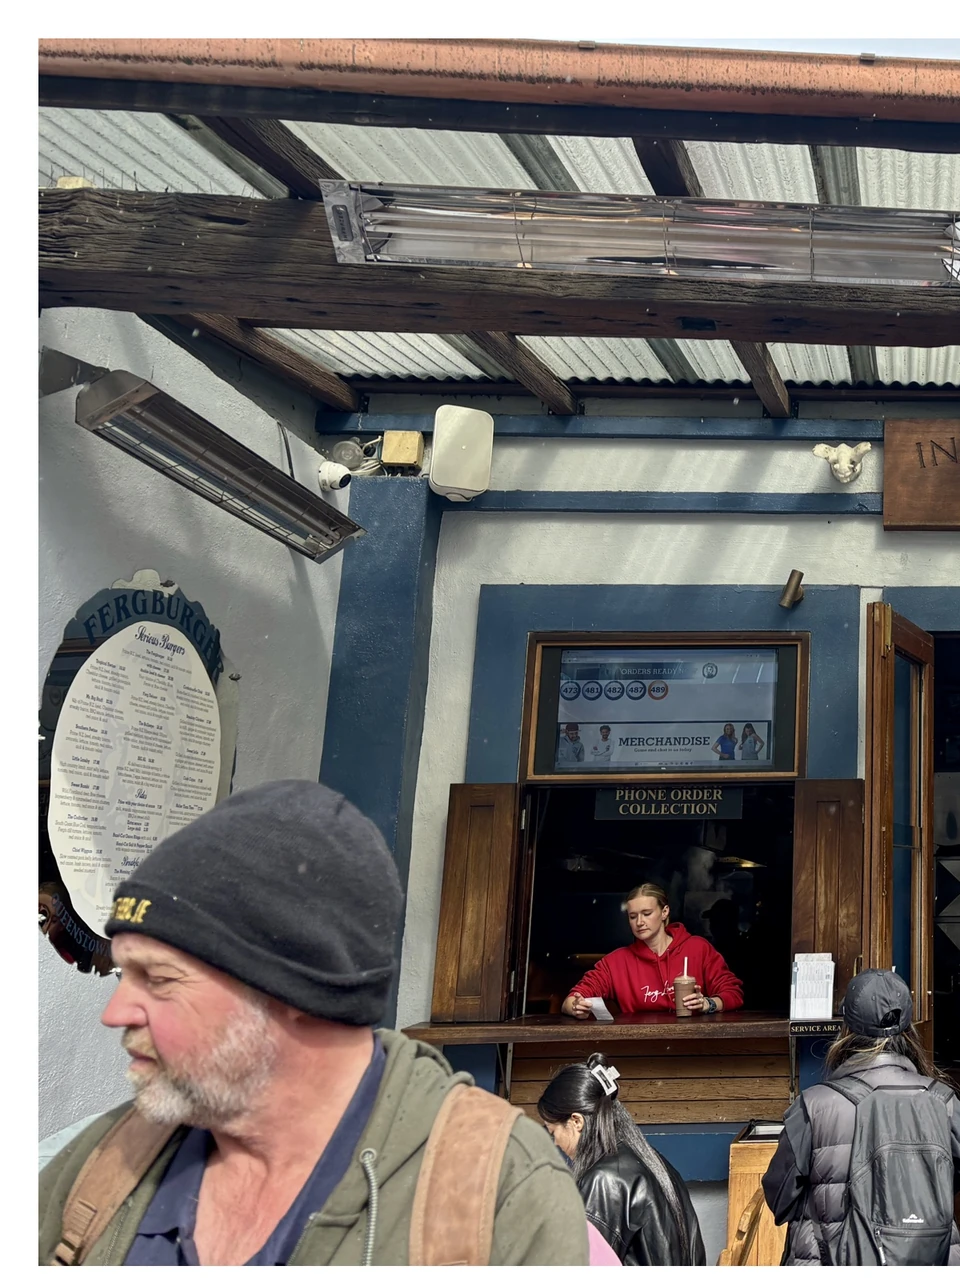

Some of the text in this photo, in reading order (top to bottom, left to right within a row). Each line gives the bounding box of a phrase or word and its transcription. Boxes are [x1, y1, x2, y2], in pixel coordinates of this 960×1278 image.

[915, 436, 959, 469] IN
[83, 589, 224, 684] FERGBURGER
[134, 624, 160, 648] Serious
[159, 633, 186, 657] Burgers
[606, 686, 622, 694] 482
[618, 736, 710, 747] MERCHANDISE
[615, 789, 722, 801] PHONE ORDER
[619, 803, 718, 815] COLLECTION
